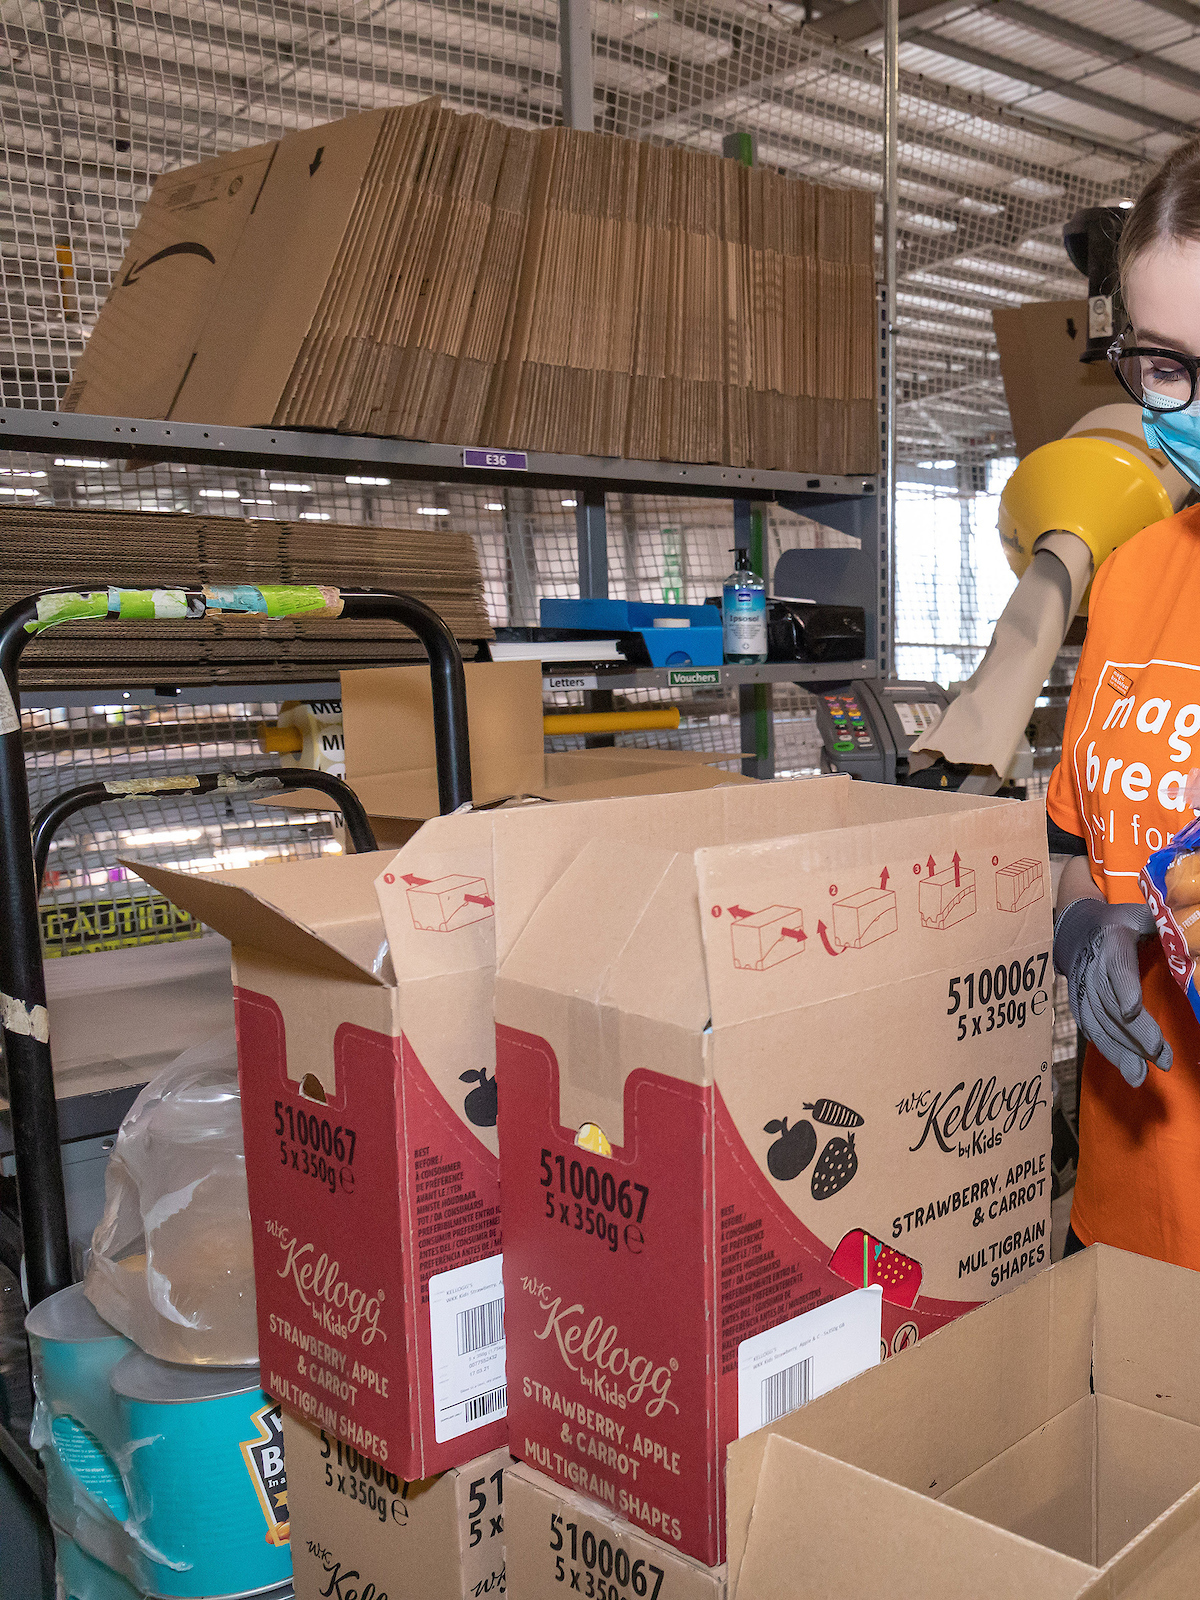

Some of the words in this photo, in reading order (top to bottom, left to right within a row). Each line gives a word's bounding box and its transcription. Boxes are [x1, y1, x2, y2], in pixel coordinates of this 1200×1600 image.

[486, 454, 508, 466] E36
[549, 676, 586, 688] Letters
[672, 670, 716, 684] Vouchers
[946, 952, 1049, 1016] 5100067
[957, 1014, 968, 1042] 5
[972, 1015, 982, 1037] x
[986, 999, 1027, 1032] 350g
[274, 1100, 356, 1166] 5100067
[908, 1074, 1047, 1153] Kellogg
[958, 1141, 970, 1158] by
[972, 1126, 1003, 1156] Kids
[280, 1140, 288, 1166] 5
[290, 1149, 300, 1172] x
[302, 1150, 336, 1194] 350g
[414, 1146, 430, 1158] BEST
[540, 1148, 650, 1224] 5100067
[892, 1173, 1002, 1238] STRAWBERRY,
[1005, 1153, 1046, 1188] APPLE
[972, 1206, 985, 1228] &
[988, 1177, 1046, 1220] CARROT
[546, 1191, 555, 1219] 5
[559, 1202, 570, 1226] x
[574, 1202, 618, 1253] 350g
[958, 1218, 1046, 1280] MULTIGRAIN
[276, 1238, 388, 1346] Kellogg
[990, 1243, 1045, 1287] SHAPES
[312, 1302, 322, 1326] by
[322, 1302, 348, 1340] Kids
[269, 1313, 350, 1378] STRAWBERRY,
[352, 1360, 389, 1399] APPLE
[297, 1354, 307, 1376] &
[309, 1363, 358, 1406] CARROT
[533, 1296, 680, 1418] Kellogg
[270, 1370, 338, 1430] MULTIGRAIN
[339, 1414, 388, 1462] SHAPES
[580, 1366, 593, 1394] by
[594, 1368, 627, 1410] Kids
[522, 1376, 630, 1451] STRAWBERRY,
[632, 1432, 681, 1476] APPLE
[560, 1422, 573, 1446] &
[576, 1432, 640, 1481] CARROT
[268, 1478, 280, 1489] In
[325, 1462, 333, 1487] 5
[336, 1474, 346, 1494] x
[350, 1474, 387, 1522] 350g
[524, 1437, 615, 1504] MULTIGRAIN
[618, 1489, 682, 1542] SHAPES
[550, 1513, 665, 1600] 5100067
[555, 1555, 565, 1582] 5
[570, 1568, 581, 1593] x
